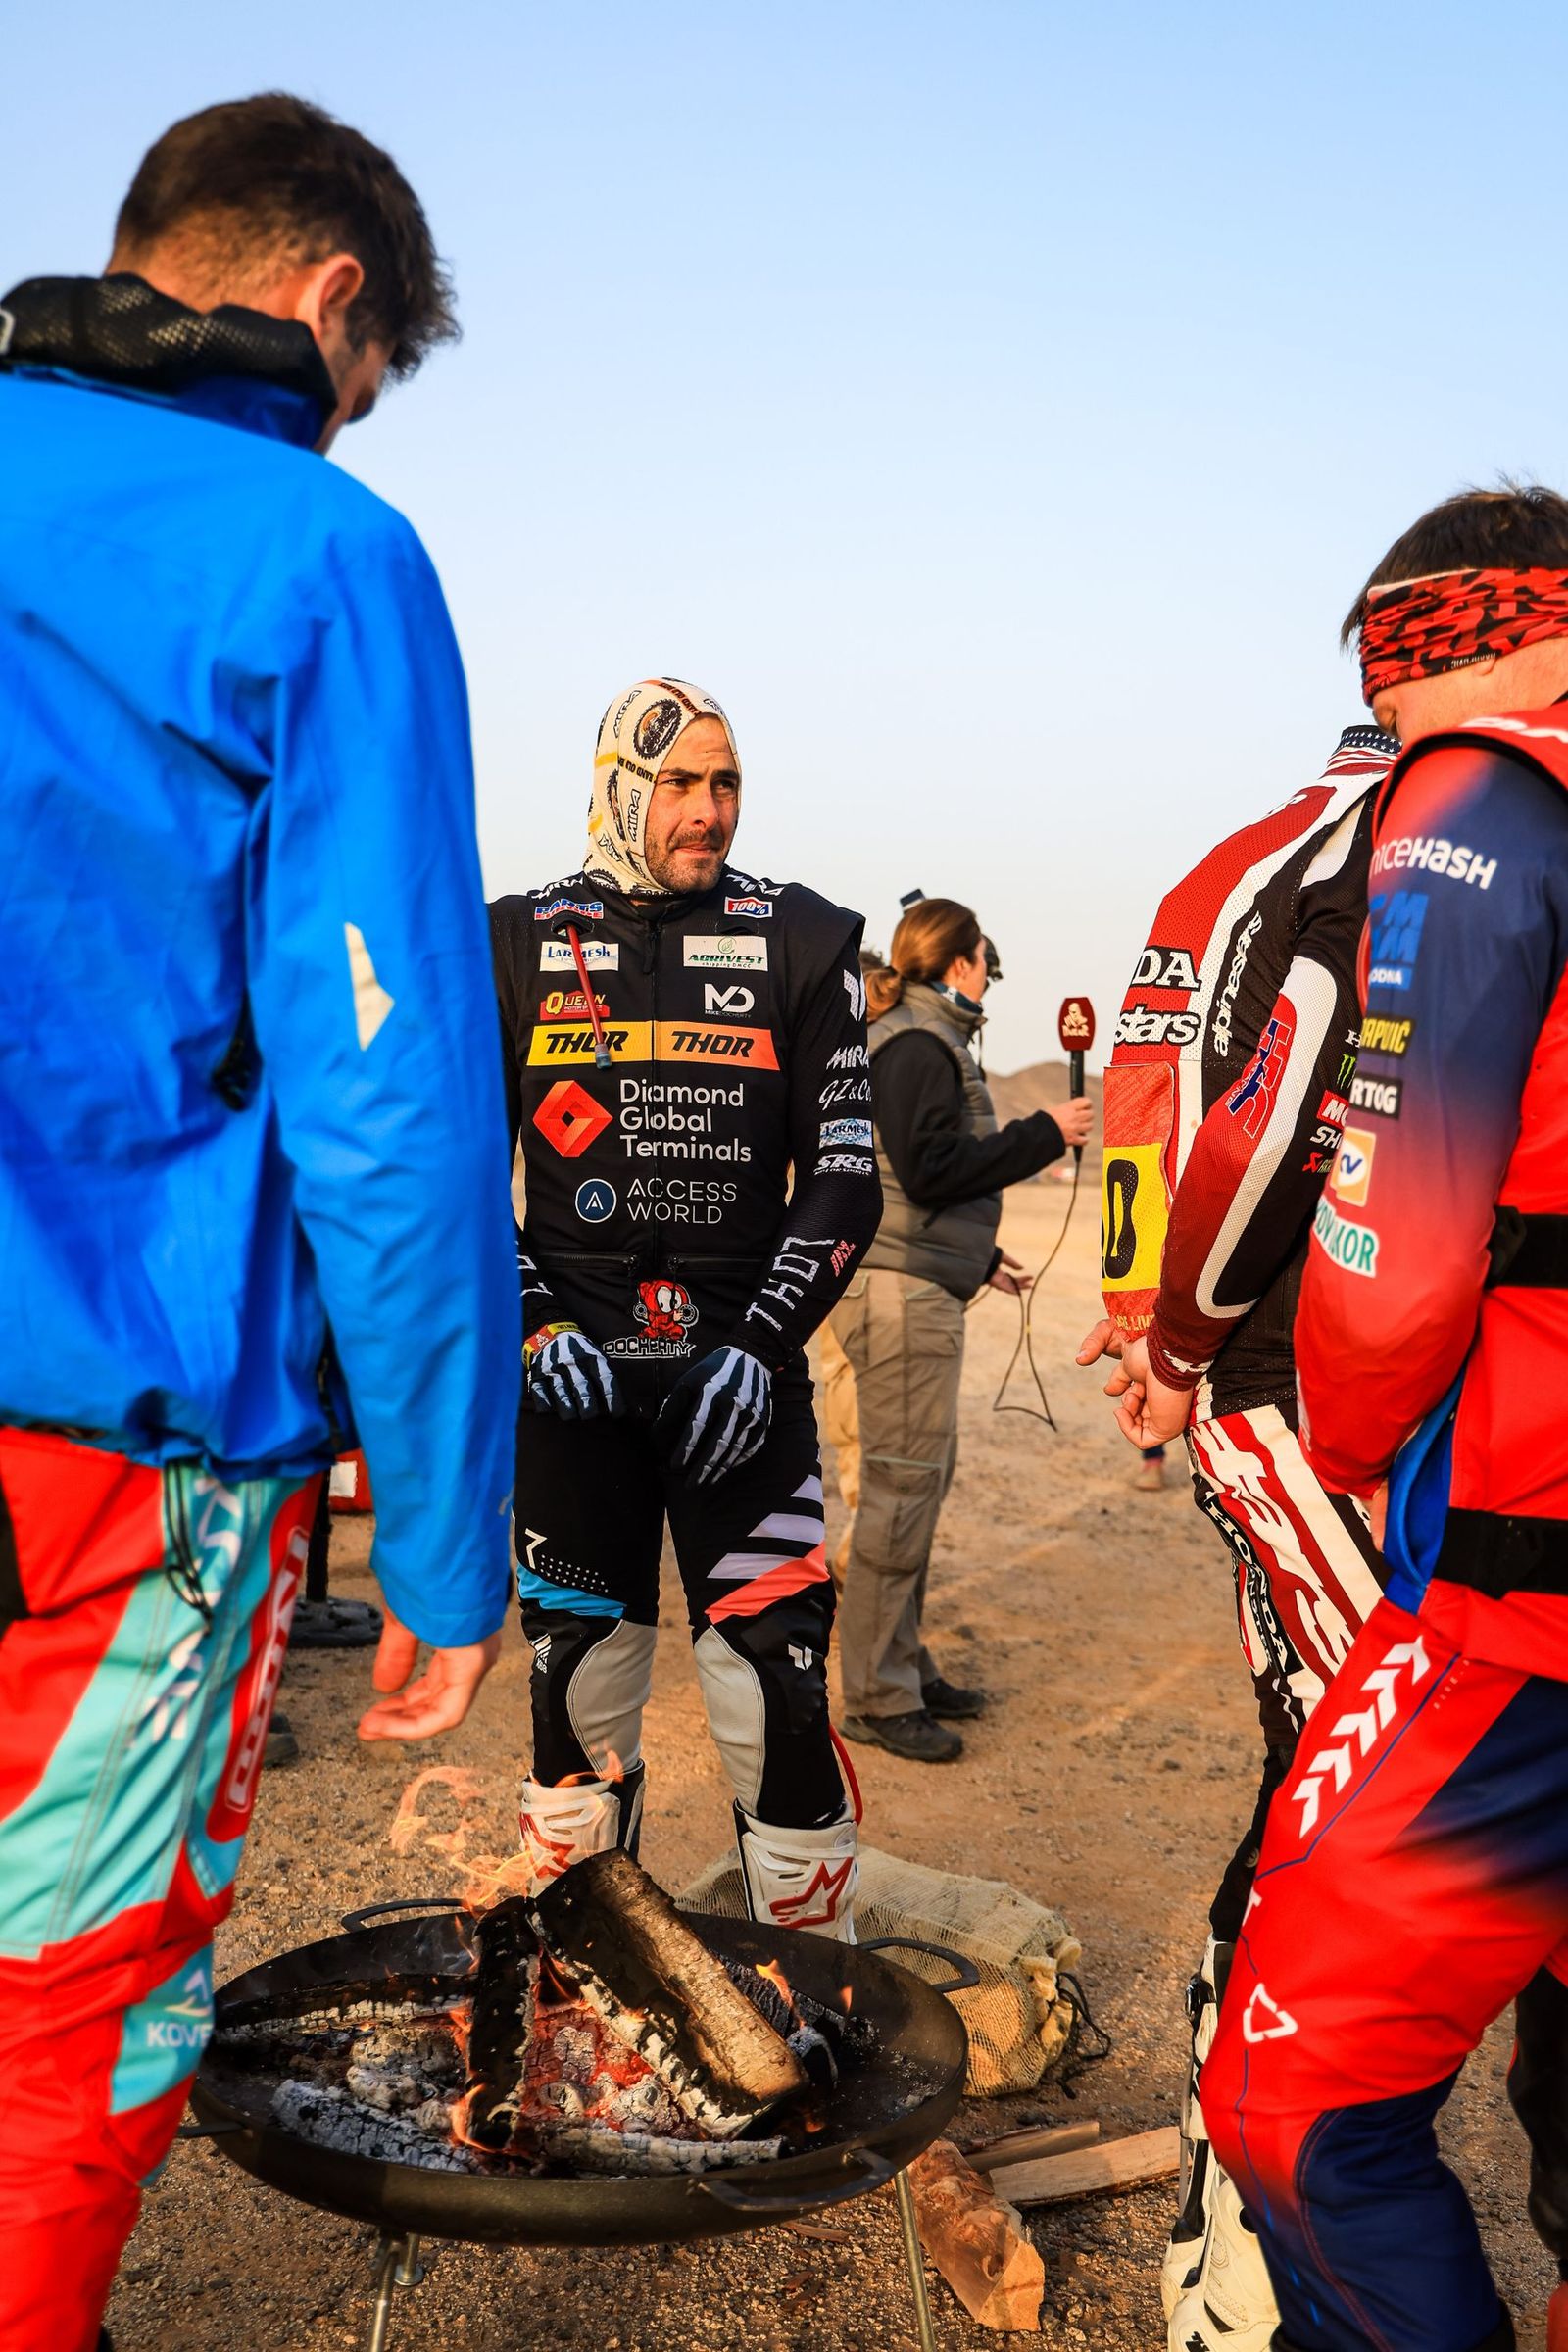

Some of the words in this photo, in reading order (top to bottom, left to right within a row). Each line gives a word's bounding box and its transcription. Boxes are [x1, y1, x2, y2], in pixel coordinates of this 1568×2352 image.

[731, 901, 766, 915] 100%
[671, 1030, 755, 1057] THOR
[620, 1079, 744, 1107] Diamond
[619, 1107, 711, 1133] Global
[619, 1134, 752, 1162] Terminals
[627, 1178, 737, 1201] ACCESS
[627, 1202, 723, 1224] WORLD
[603, 1336, 697, 1359] DOCHERTY
[1205, 1500, 1288, 1673] HONDA
